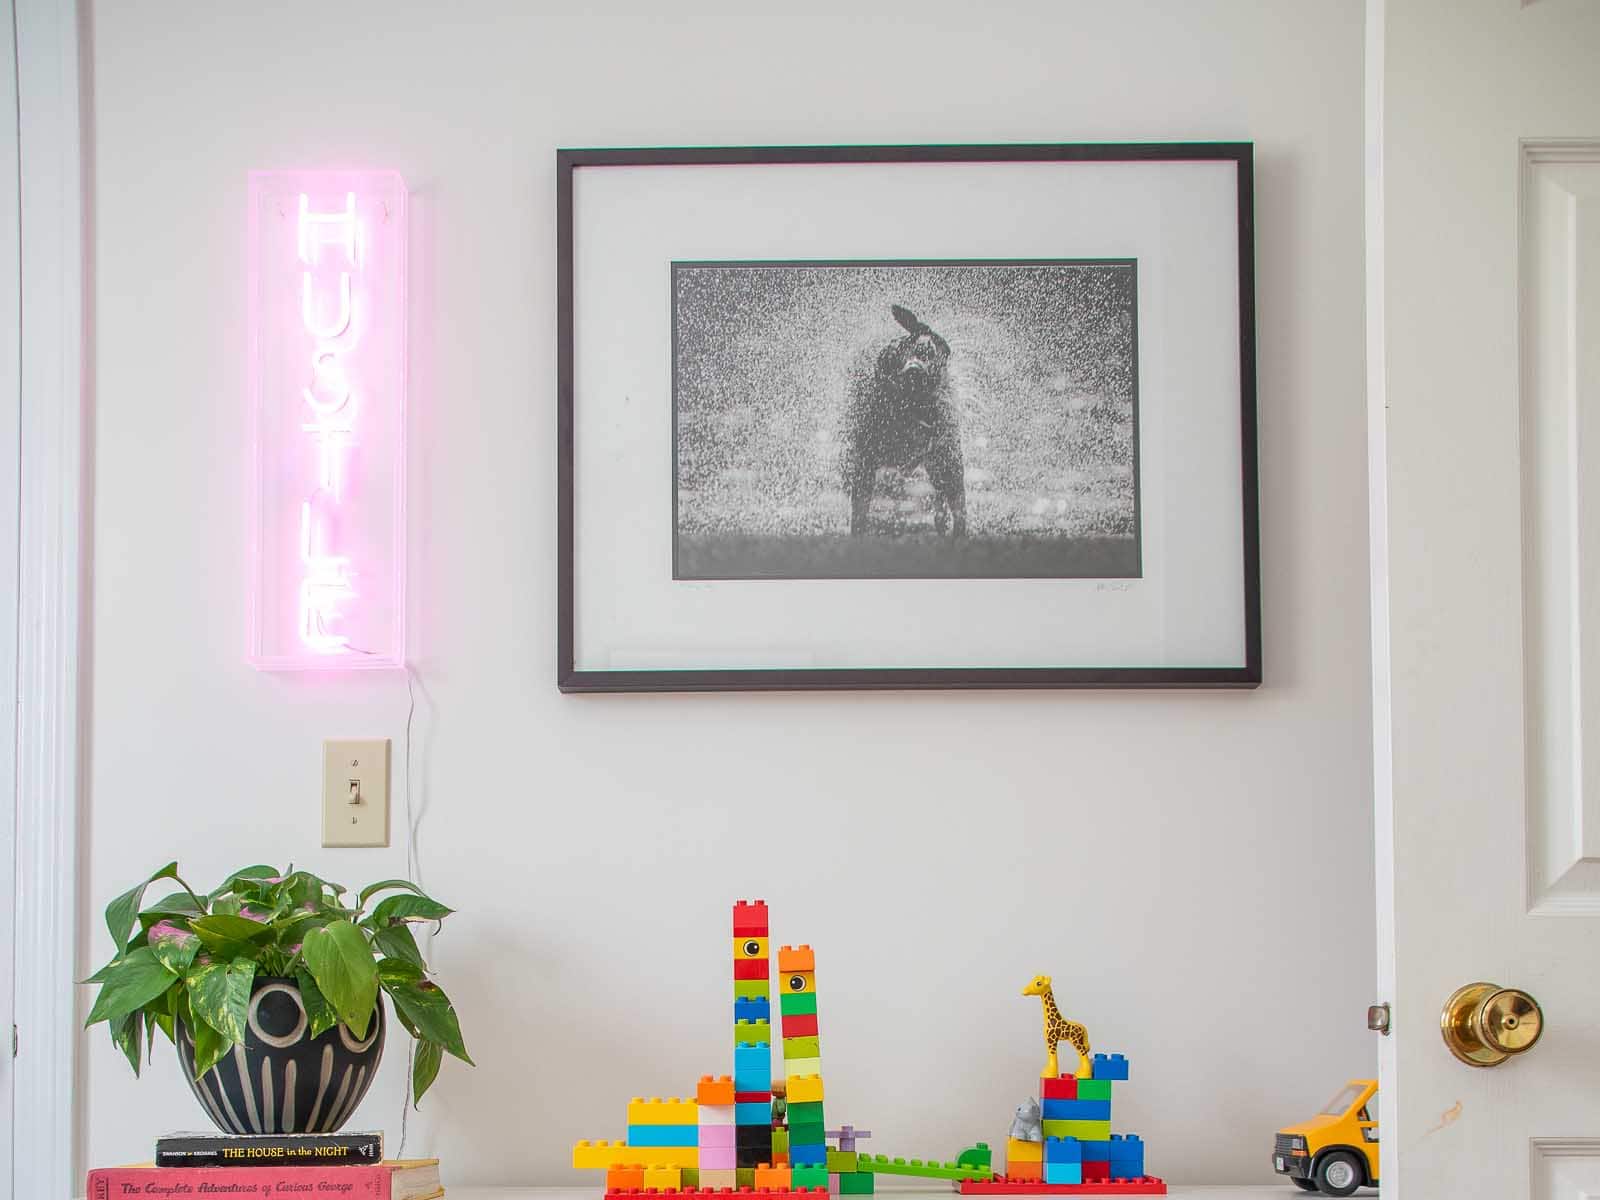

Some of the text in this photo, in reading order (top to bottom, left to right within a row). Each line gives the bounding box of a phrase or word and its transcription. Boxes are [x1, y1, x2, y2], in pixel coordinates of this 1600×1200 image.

[298, 190, 357, 655] HUSTLE
[223, 1146, 349, 1158] THE HOUSE in the NIGHT
[120, 1182, 141, 1193] The
[144, 1183, 193, 1197] Complete
[198, 1182, 258, 1194] Adventures
[275, 1181, 314, 1193] Curious
[317, 1181, 353, 1194] George
